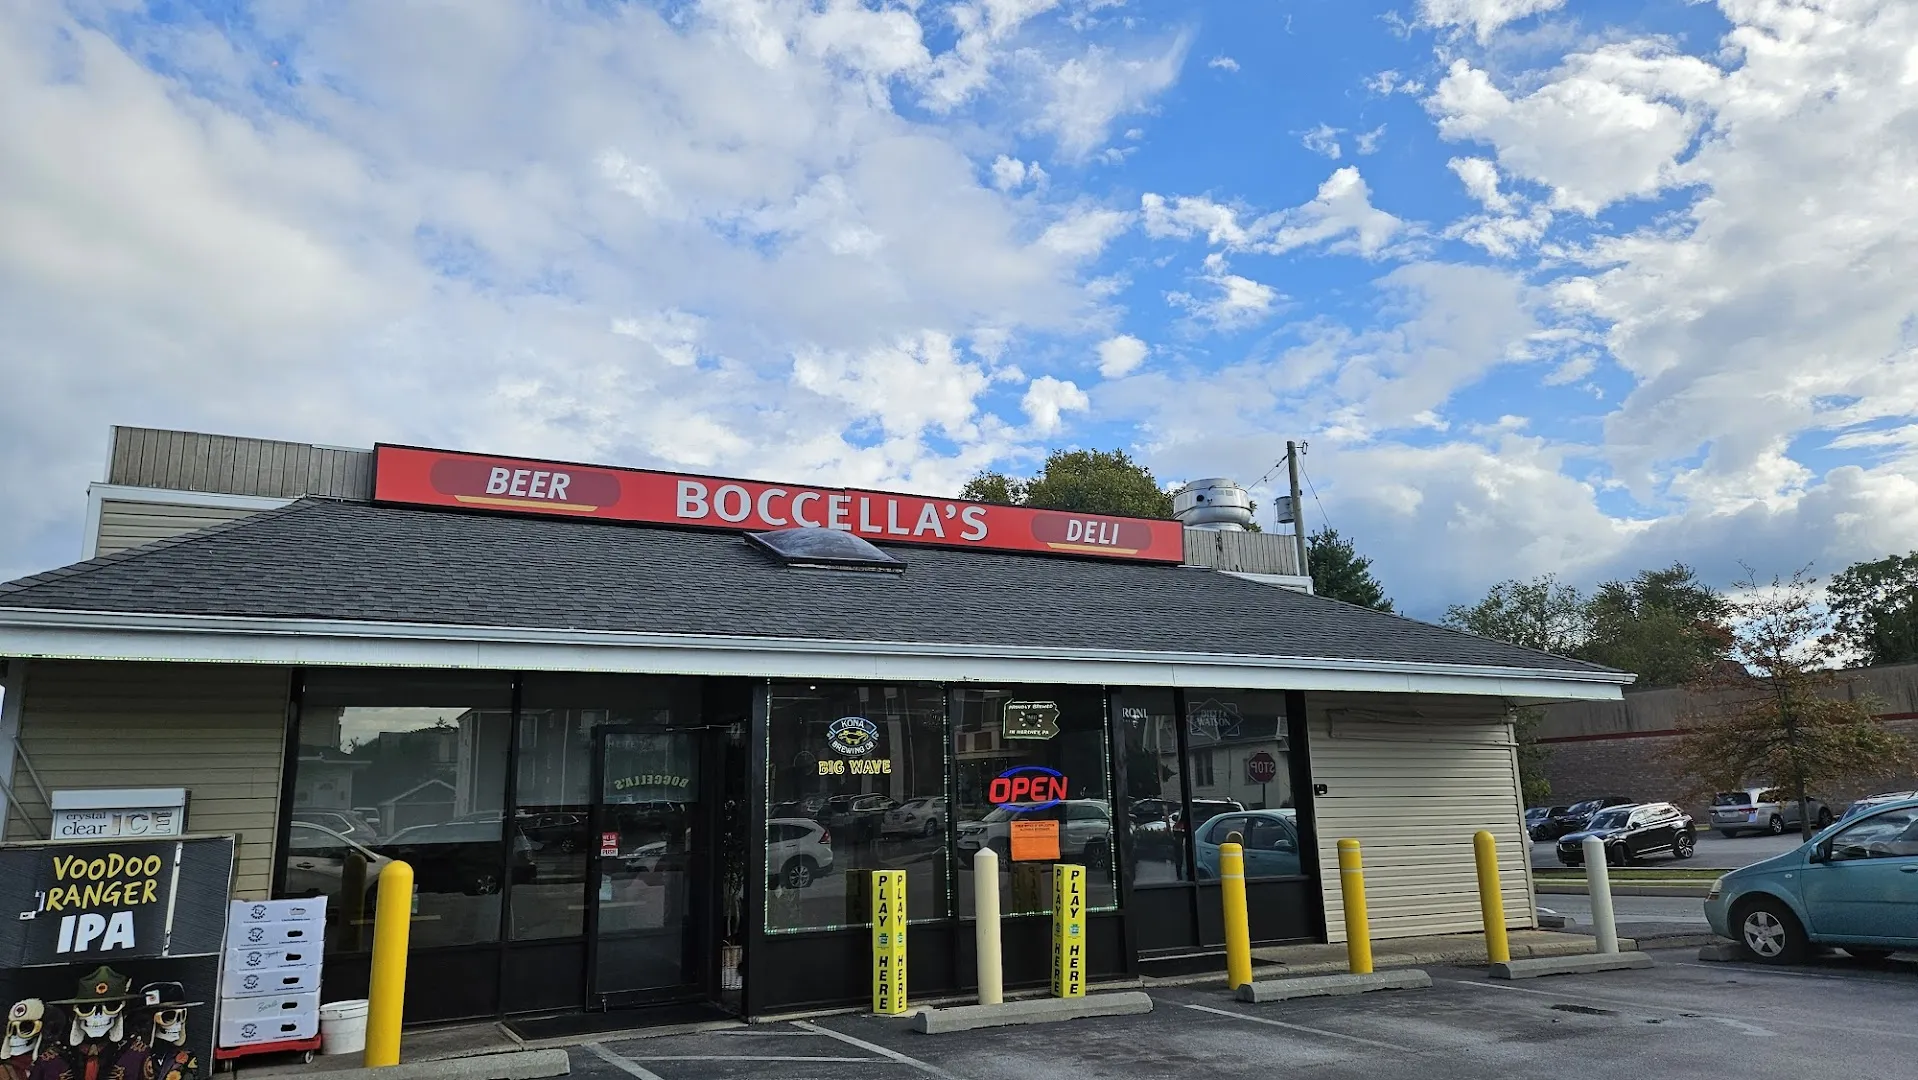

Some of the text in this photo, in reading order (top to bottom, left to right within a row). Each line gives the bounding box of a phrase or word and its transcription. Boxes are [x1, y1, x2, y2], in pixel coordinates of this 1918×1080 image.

[486, 467, 571, 500] BEER
[676, 480, 988, 541] BOCCELLA'S
[1066, 519, 1120, 545] DELI
[841, 719, 864, 728] KONA
[831, 740, 865, 754] BREWING
[818, 760, 892, 775] BIG WAVE
[989, 776, 1068, 803] OPEN
[62, 822, 107, 836] clear
[66, 811, 106, 822] crystal
[112, 811, 172, 836] ICE
[53, 853, 161, 880] VOODOO
[46, 879, 157, 911] RANGER
[878, 875, 888, 927] PLAY
[1070, 870, 1080, 918] PLAY
[57, 911, 135, 953] IPA
[878, 956, 889, 1010] HERE
[1070, 945, 1080, 994] HERE
